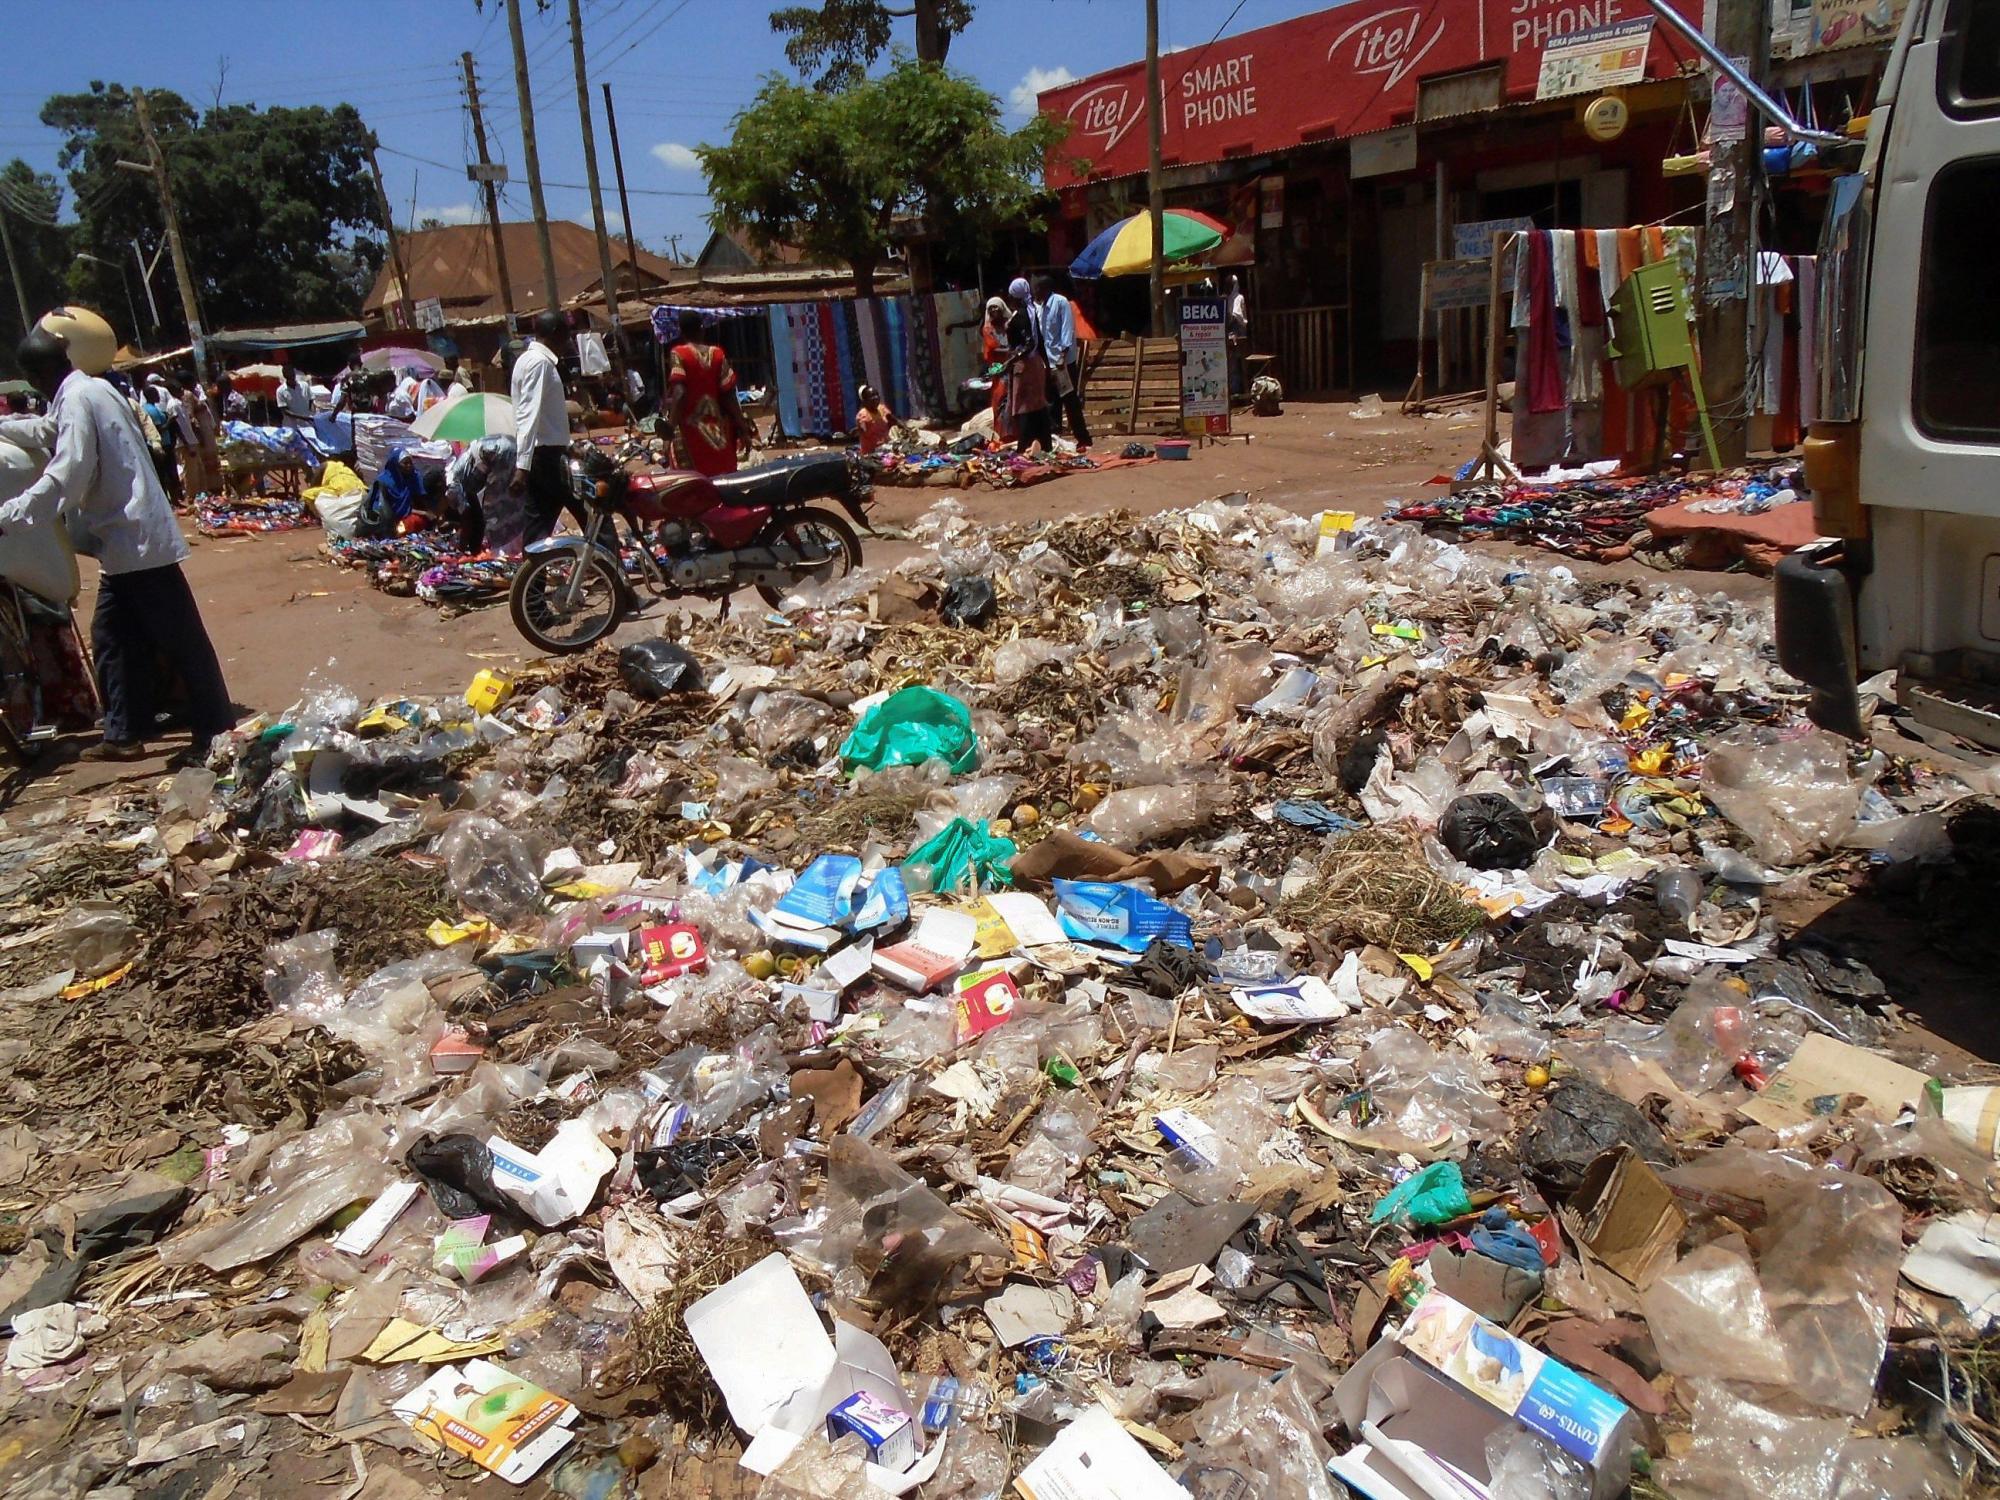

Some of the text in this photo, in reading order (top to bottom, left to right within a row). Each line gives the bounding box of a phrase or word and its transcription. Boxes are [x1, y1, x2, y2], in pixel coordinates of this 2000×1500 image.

[1354, 12, 1420, 67] itel
[1512, 0, 1622, 52] PHONE
[1568, 34, 1589, 46] phone
[1182, 54, 1253, 98] SMART
[1084, 90, 1128, 129] itel
[1184, 87, 1256, 128] PHONE
[1182, 305, 1219, 319] BEKA
[446, 1421, 486, 1448] MEDISAFE
[512, 1403, 559, 1440] MEDISAFE
[1558, 1415, 1598, 1446] CONTUS
